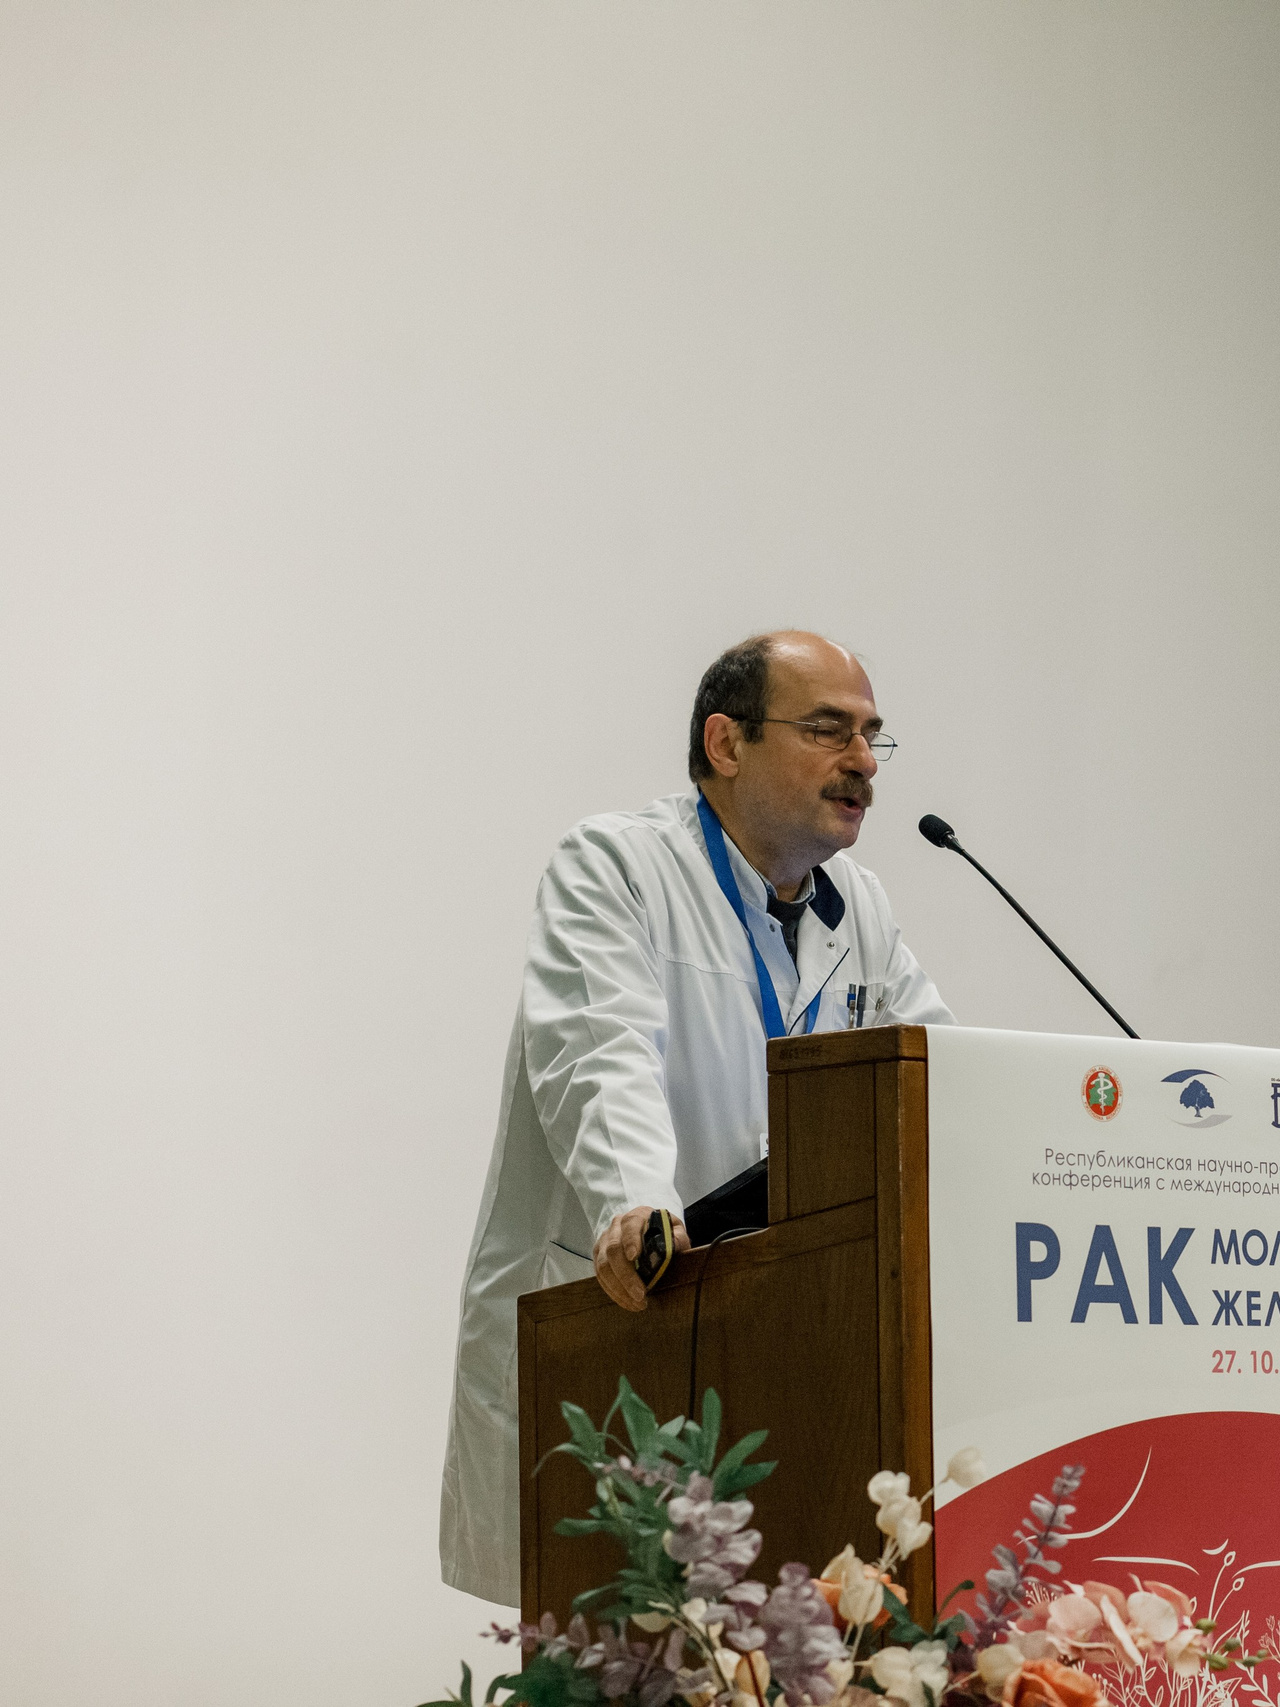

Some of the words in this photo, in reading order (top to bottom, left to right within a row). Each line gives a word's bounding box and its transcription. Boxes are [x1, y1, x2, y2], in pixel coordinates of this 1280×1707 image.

[1045, 1148, 1192, 1171] Республиканская
[1032, 1170, 1151, 1191] конференция
[1156, 1177, 1165, 1190] с
[1015, 1221, 1200, 1326] РАК
[1211, 1349, 1242, 1374] 27.
[1250, 1350, 1279, 1375] 10.
